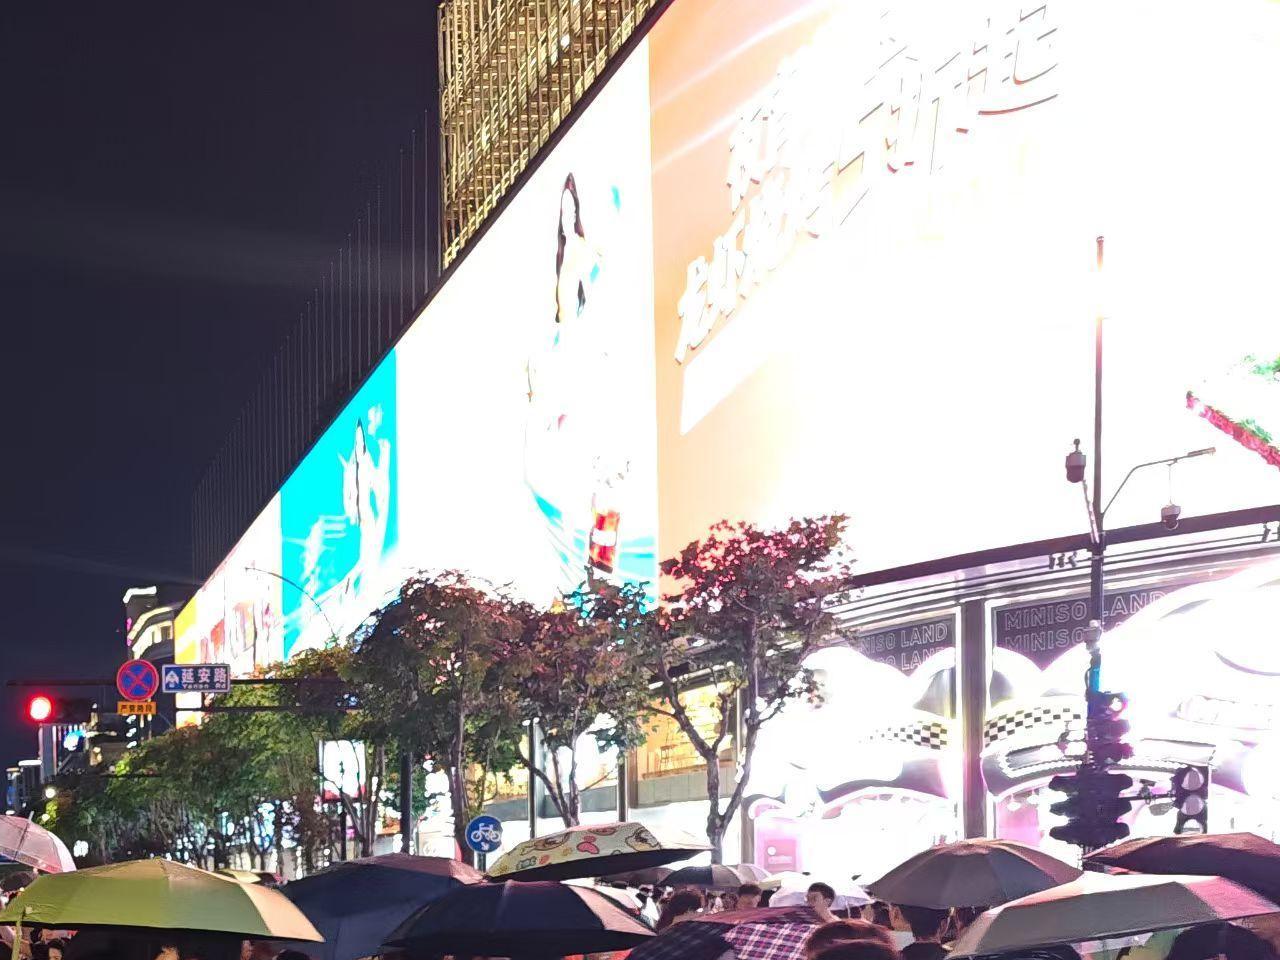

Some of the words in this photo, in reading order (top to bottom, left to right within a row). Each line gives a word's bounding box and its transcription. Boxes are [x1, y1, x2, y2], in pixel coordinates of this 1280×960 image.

[1004, 600, 1088, 631] MINISO
[901, 622, 948, 647] LAND
[181, 667, 227, 684] 延安路
